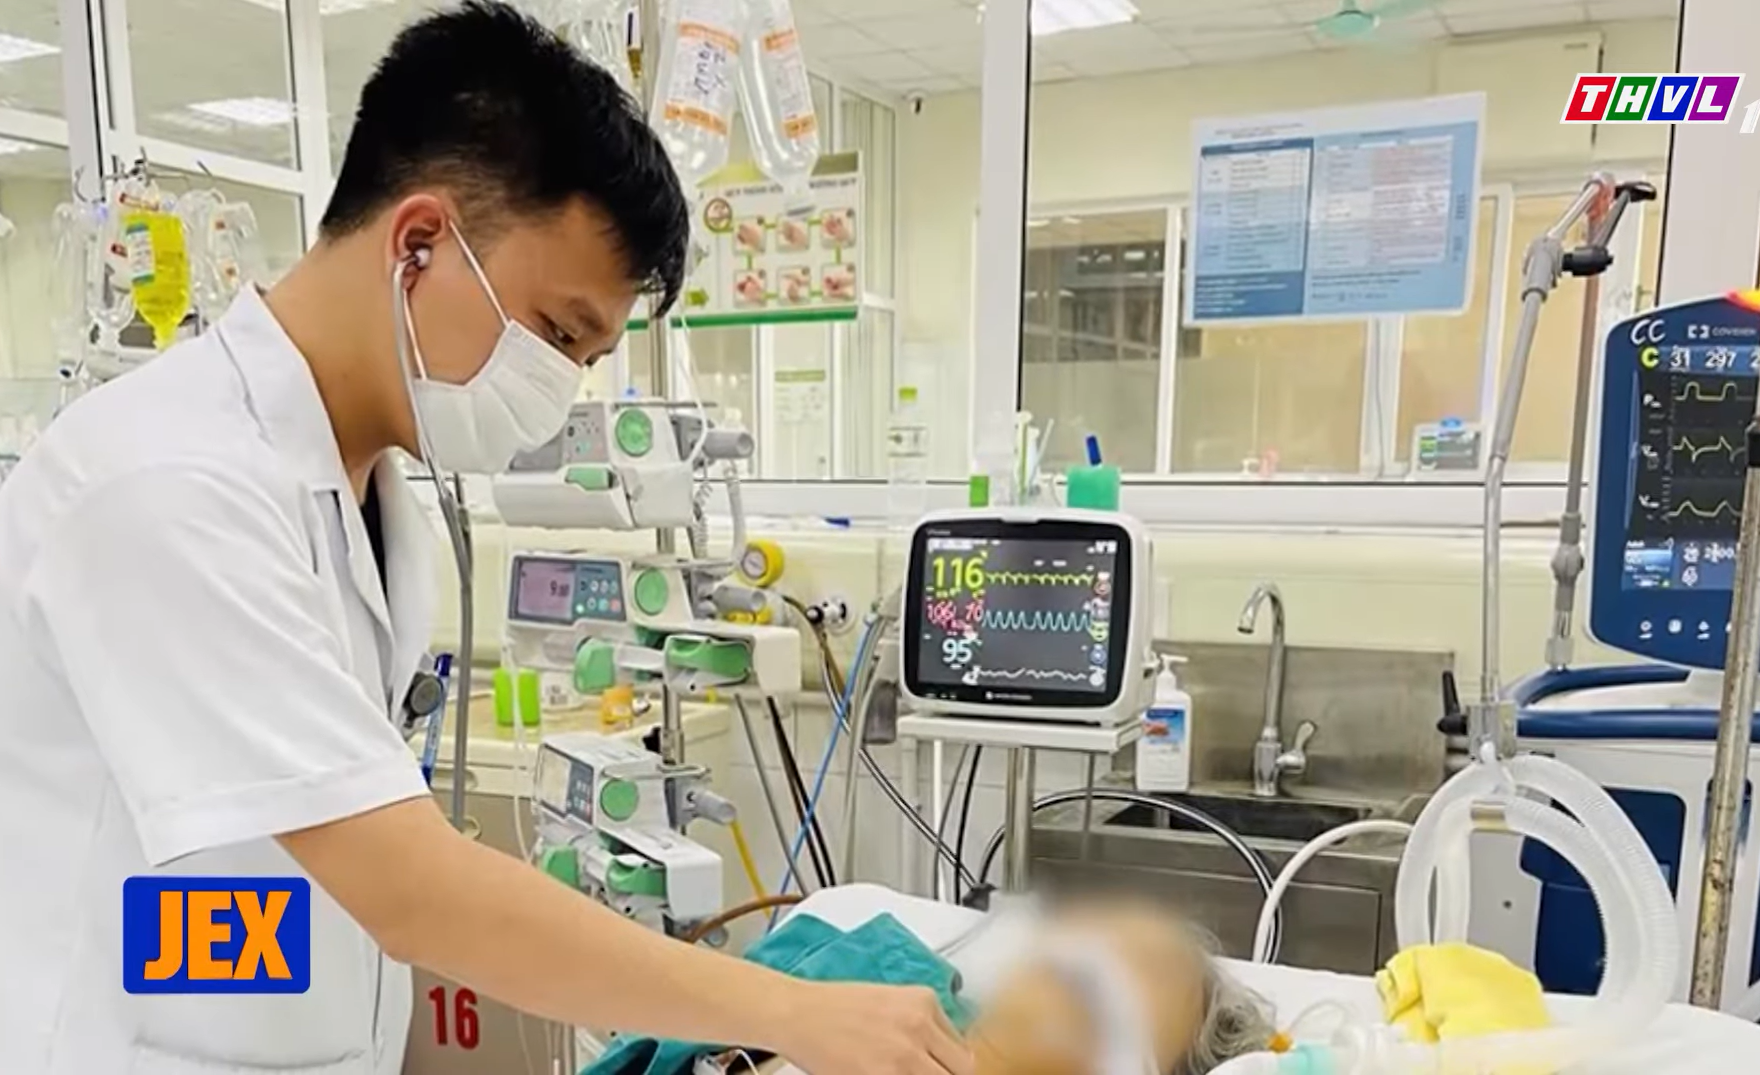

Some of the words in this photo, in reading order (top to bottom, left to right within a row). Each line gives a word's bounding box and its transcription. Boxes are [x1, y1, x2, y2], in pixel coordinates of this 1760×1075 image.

[1641, 346, 1659, 368] C
[933, 556, 984, 588] 116
[942, 638, 972, 663] 95
[429, 986, 480, 1050] 16
